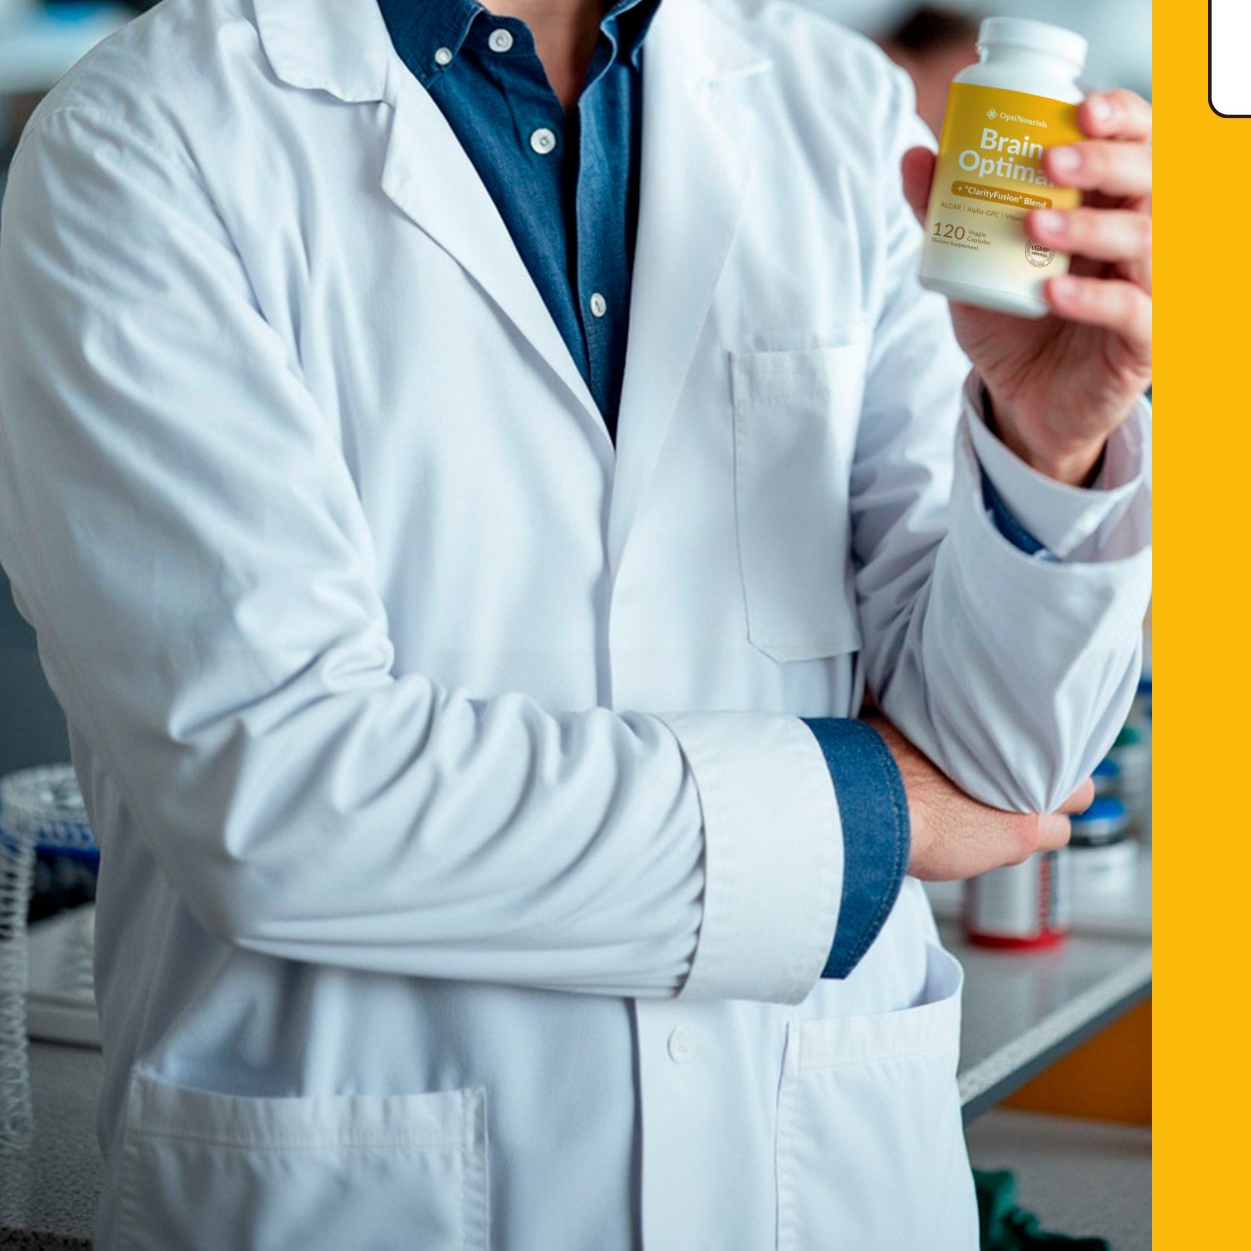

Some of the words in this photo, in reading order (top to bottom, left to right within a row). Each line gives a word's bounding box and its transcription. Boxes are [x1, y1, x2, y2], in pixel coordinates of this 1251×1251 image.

[980, 127, 1044, 160] Brain
[959, 149, 1055, 188] Optima
[1023, 197, 1046, 209] Blend
[933, 221, 966, 241] 120
